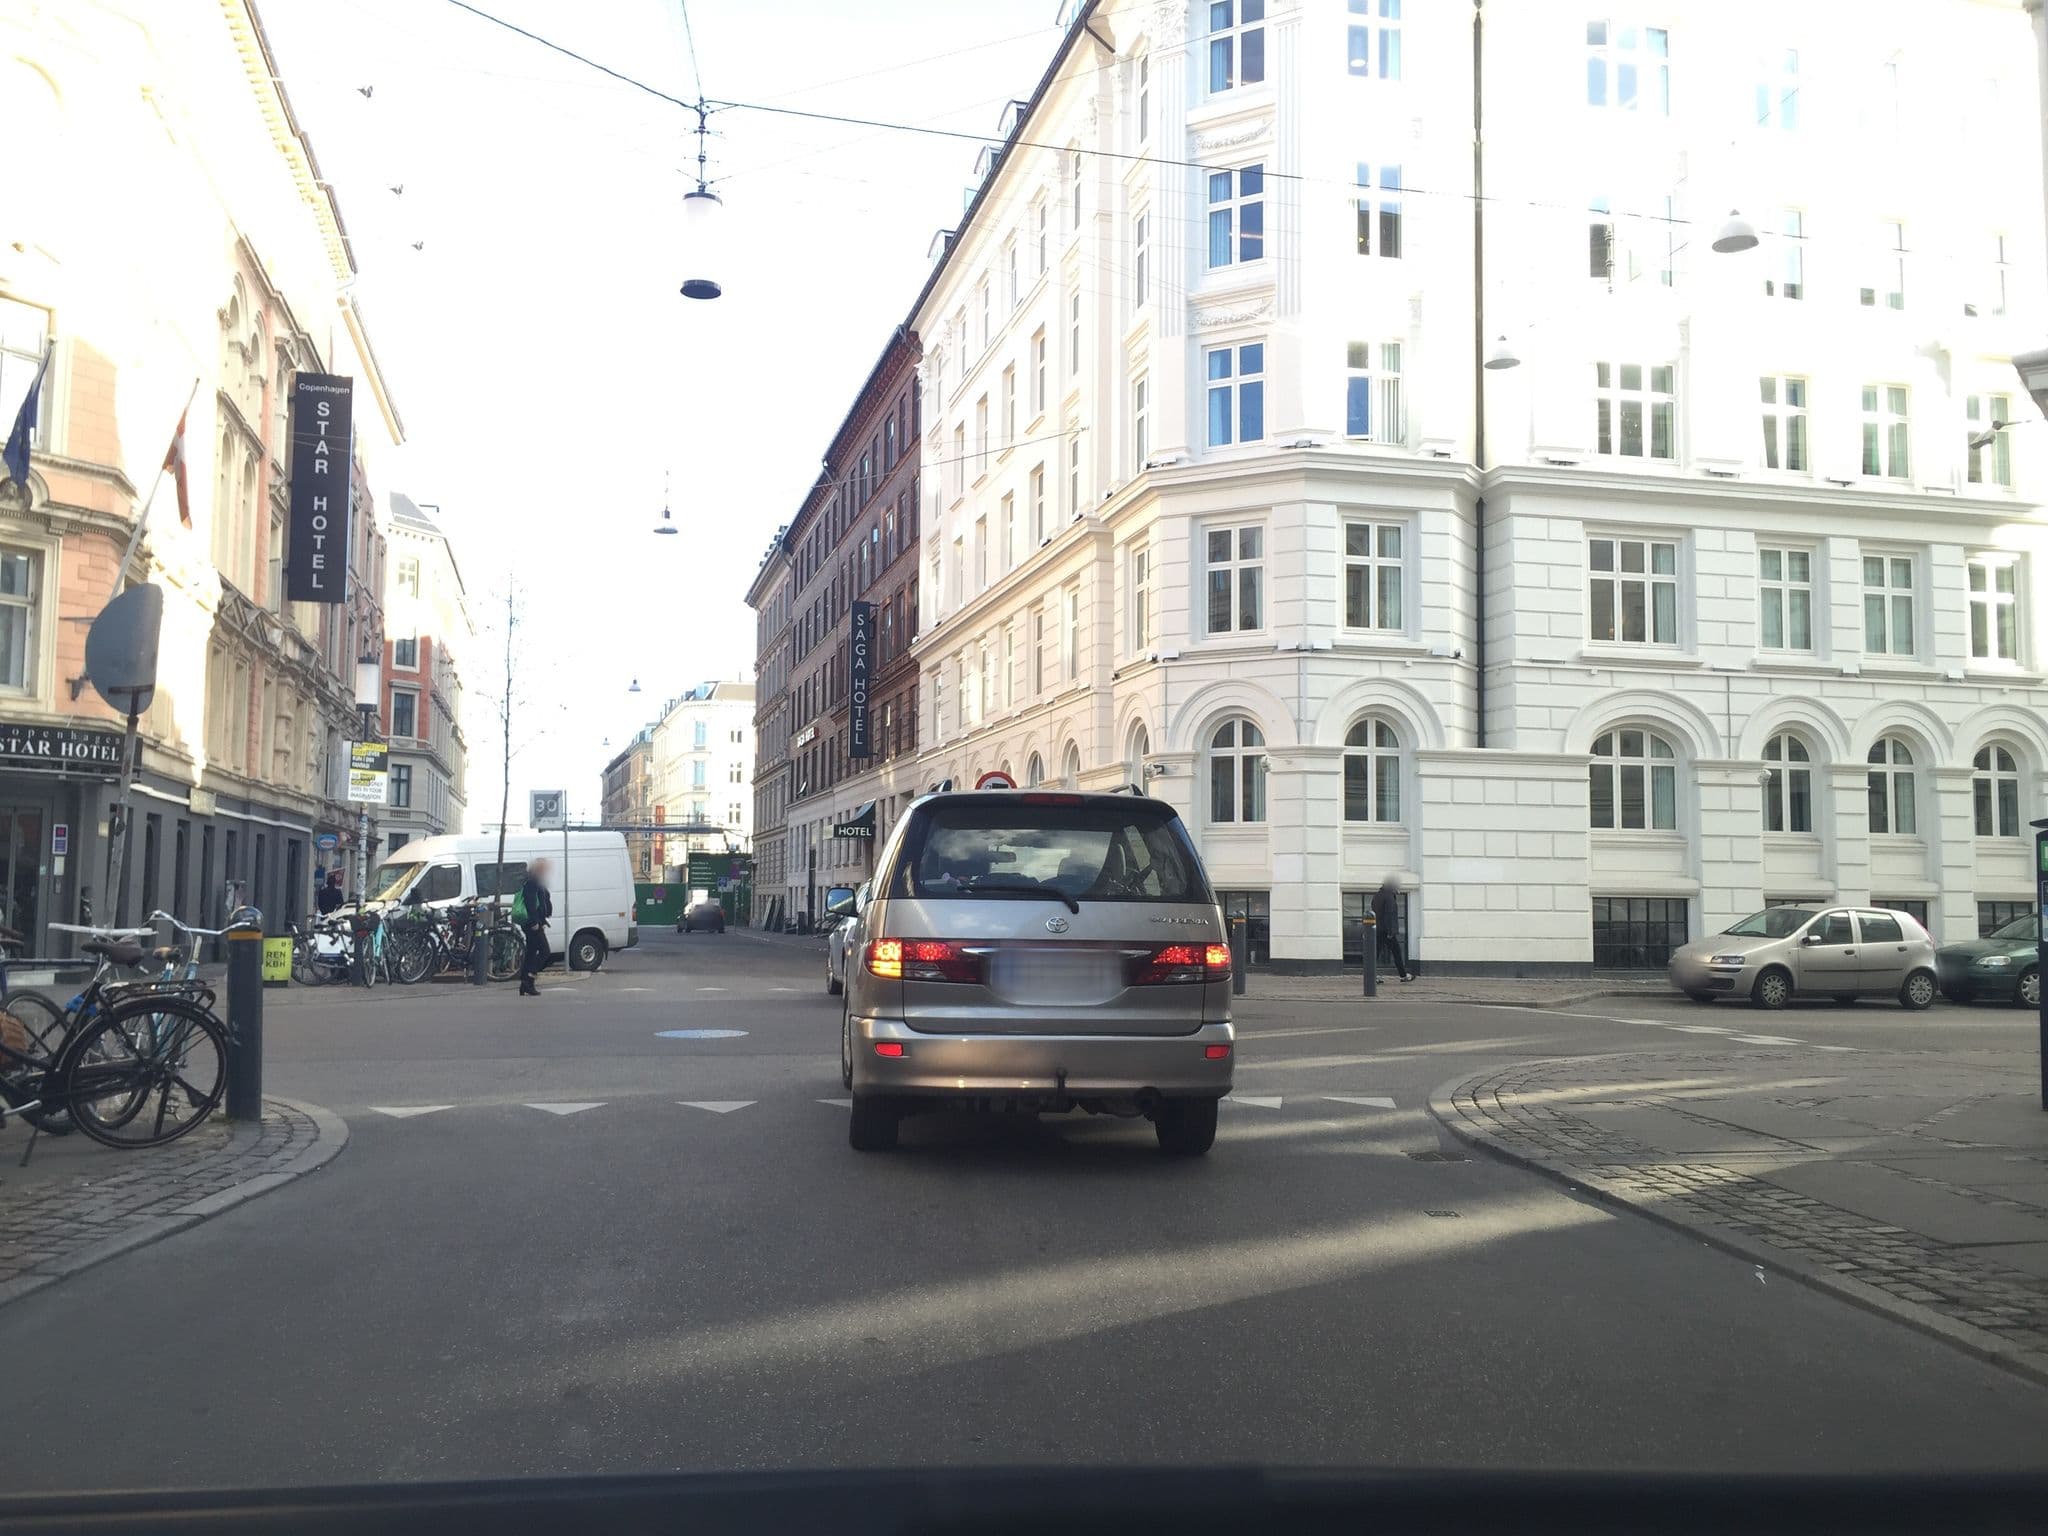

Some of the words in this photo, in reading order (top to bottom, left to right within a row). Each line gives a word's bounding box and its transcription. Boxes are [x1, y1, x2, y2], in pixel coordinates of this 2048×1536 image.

[299, 382, 350, 395] Copenhagen
[314, 401, 330, 474] STAR
[312, 496, 328, 588] HOTEL
[855, 614, 866, 669] SAGA
[854, 679, 866, 744] HOTEL
[0, 726, 120, 745] openhagen
[61, 742, 120, 761] HOTEL
[535, 799, 557, 812] 30
[838, 827, 872, 836] HOTEL
[266, 951, 286, 959] REN
